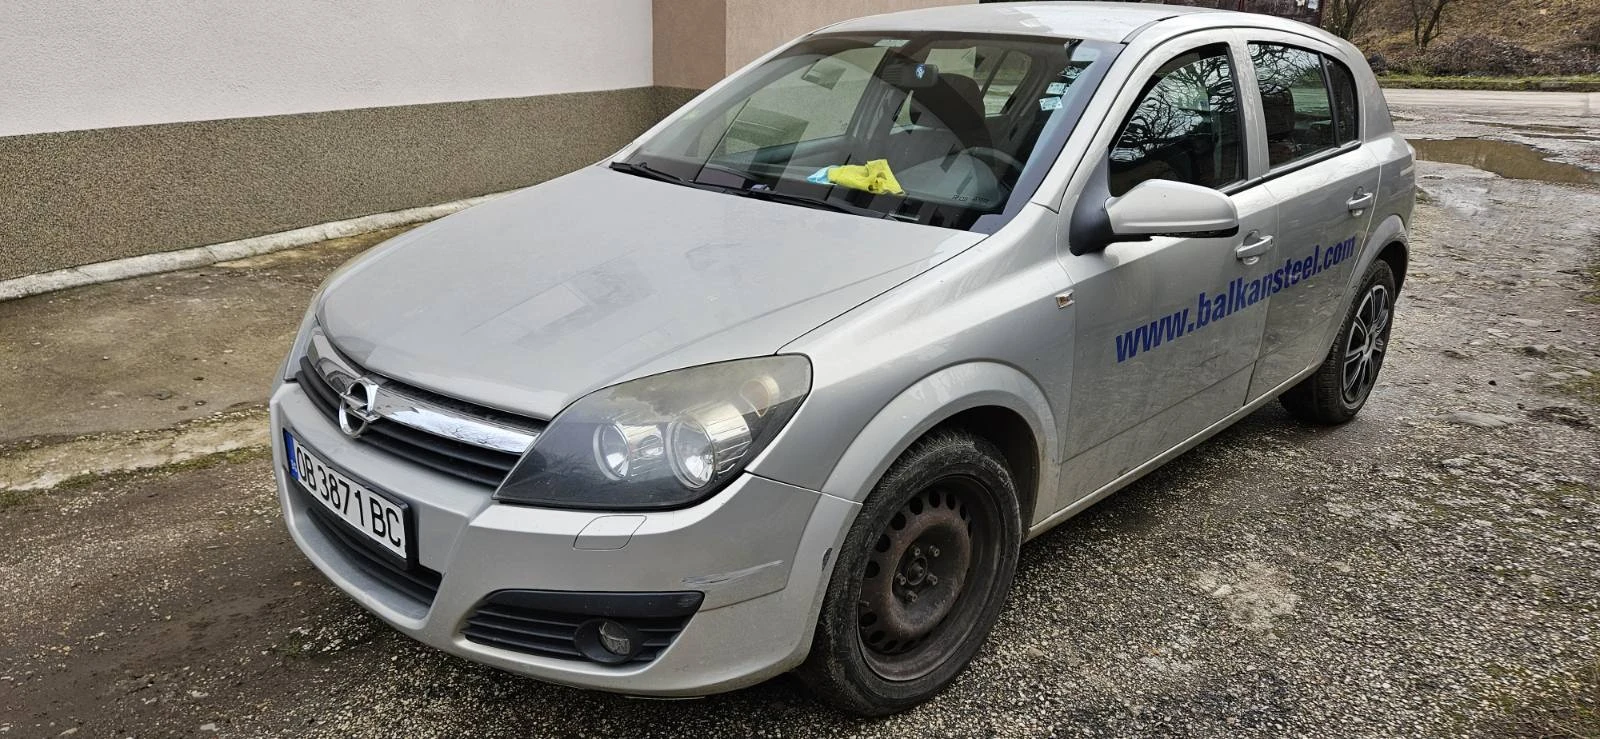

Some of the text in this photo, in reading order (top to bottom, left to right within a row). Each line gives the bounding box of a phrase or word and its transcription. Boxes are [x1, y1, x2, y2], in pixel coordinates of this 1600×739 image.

[1115, 235, 1356, 364] www.balkansteel.com
[296, 446, 401, 548] OB 3871 BC
